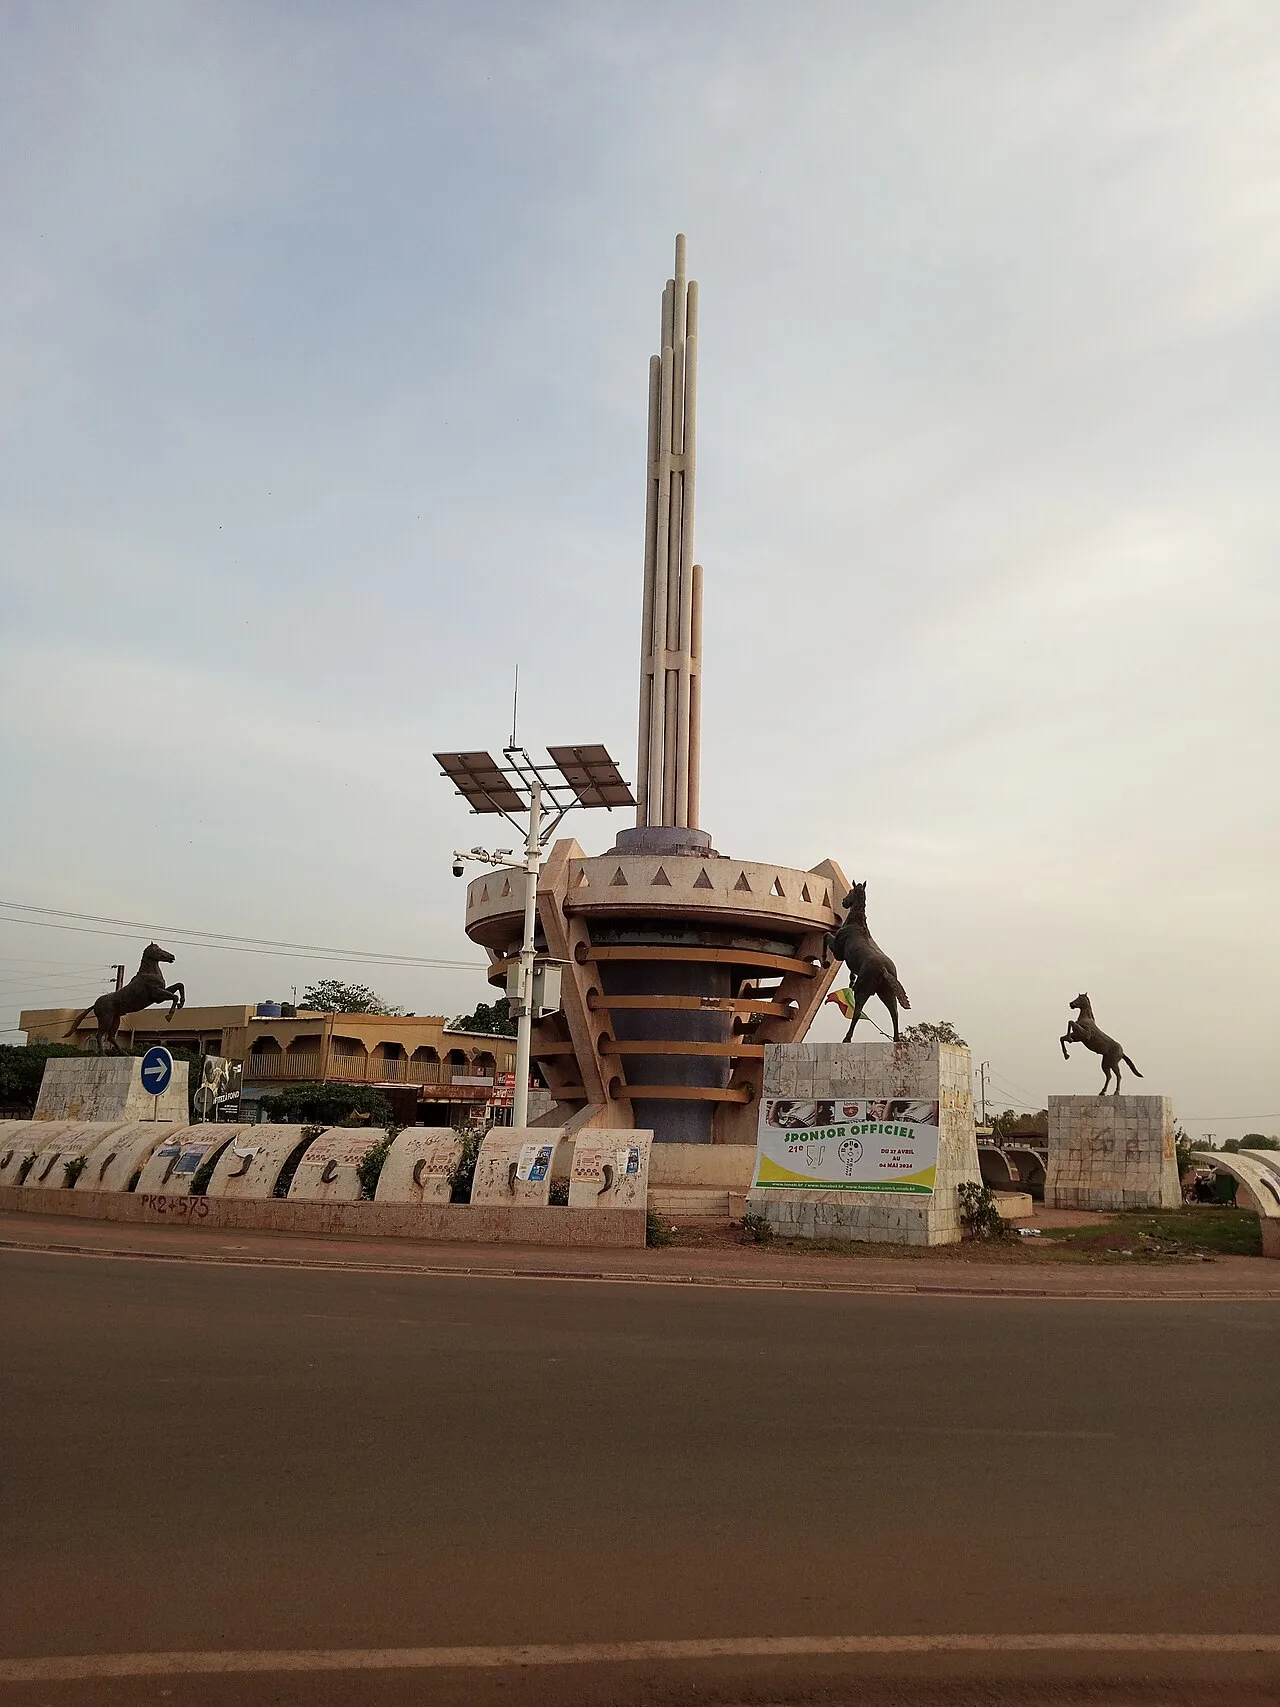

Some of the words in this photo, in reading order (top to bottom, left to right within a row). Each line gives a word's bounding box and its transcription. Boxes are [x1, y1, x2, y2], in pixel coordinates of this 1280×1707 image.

[228, 1090, 240, 1101] FOND
[784, 1127, 846, 1142] SPONSOR
[850, 1124, 916, 1139] OFFICIEL
